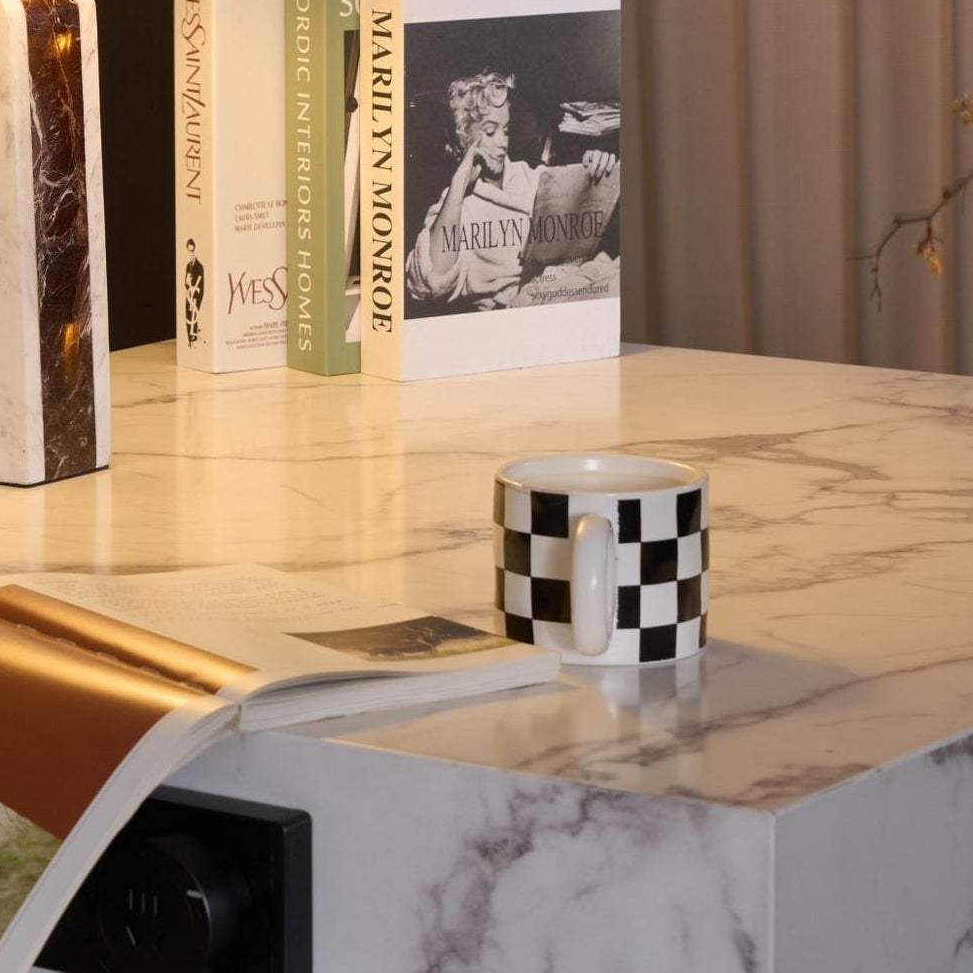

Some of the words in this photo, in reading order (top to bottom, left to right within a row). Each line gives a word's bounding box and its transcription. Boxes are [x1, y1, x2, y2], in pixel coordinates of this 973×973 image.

[371, 9, 393, 172] MARILYN
[297, 93, 312, 240] INTERIORS
[442, 217, 523, 253] MARILYN
[527, 210, 604, 245] MONROE
[298, 250, 312, 352] HOMES
[371, 179, 393, 333] MONROE
